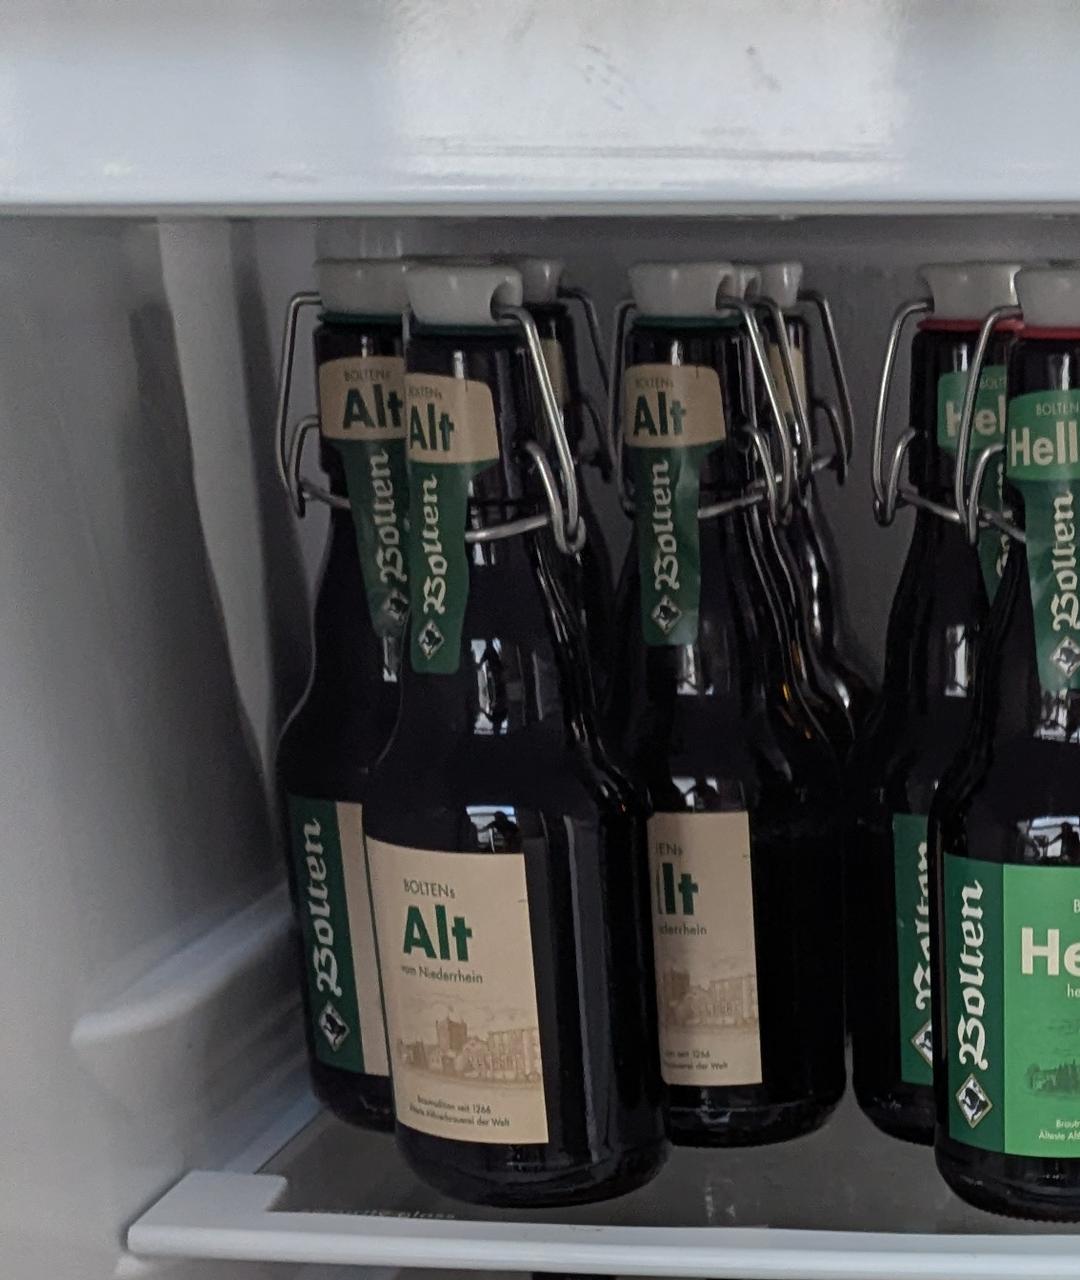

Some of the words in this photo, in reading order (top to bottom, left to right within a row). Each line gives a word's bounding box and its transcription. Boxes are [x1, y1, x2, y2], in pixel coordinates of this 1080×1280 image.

[343, 384, 404, 430] Alt
[410, 402, 454, 451] Alt
[633, 391, 687, 437] Alt
[656, 862, 699, 915] lt
[403, 904, 473, 962] Alt
